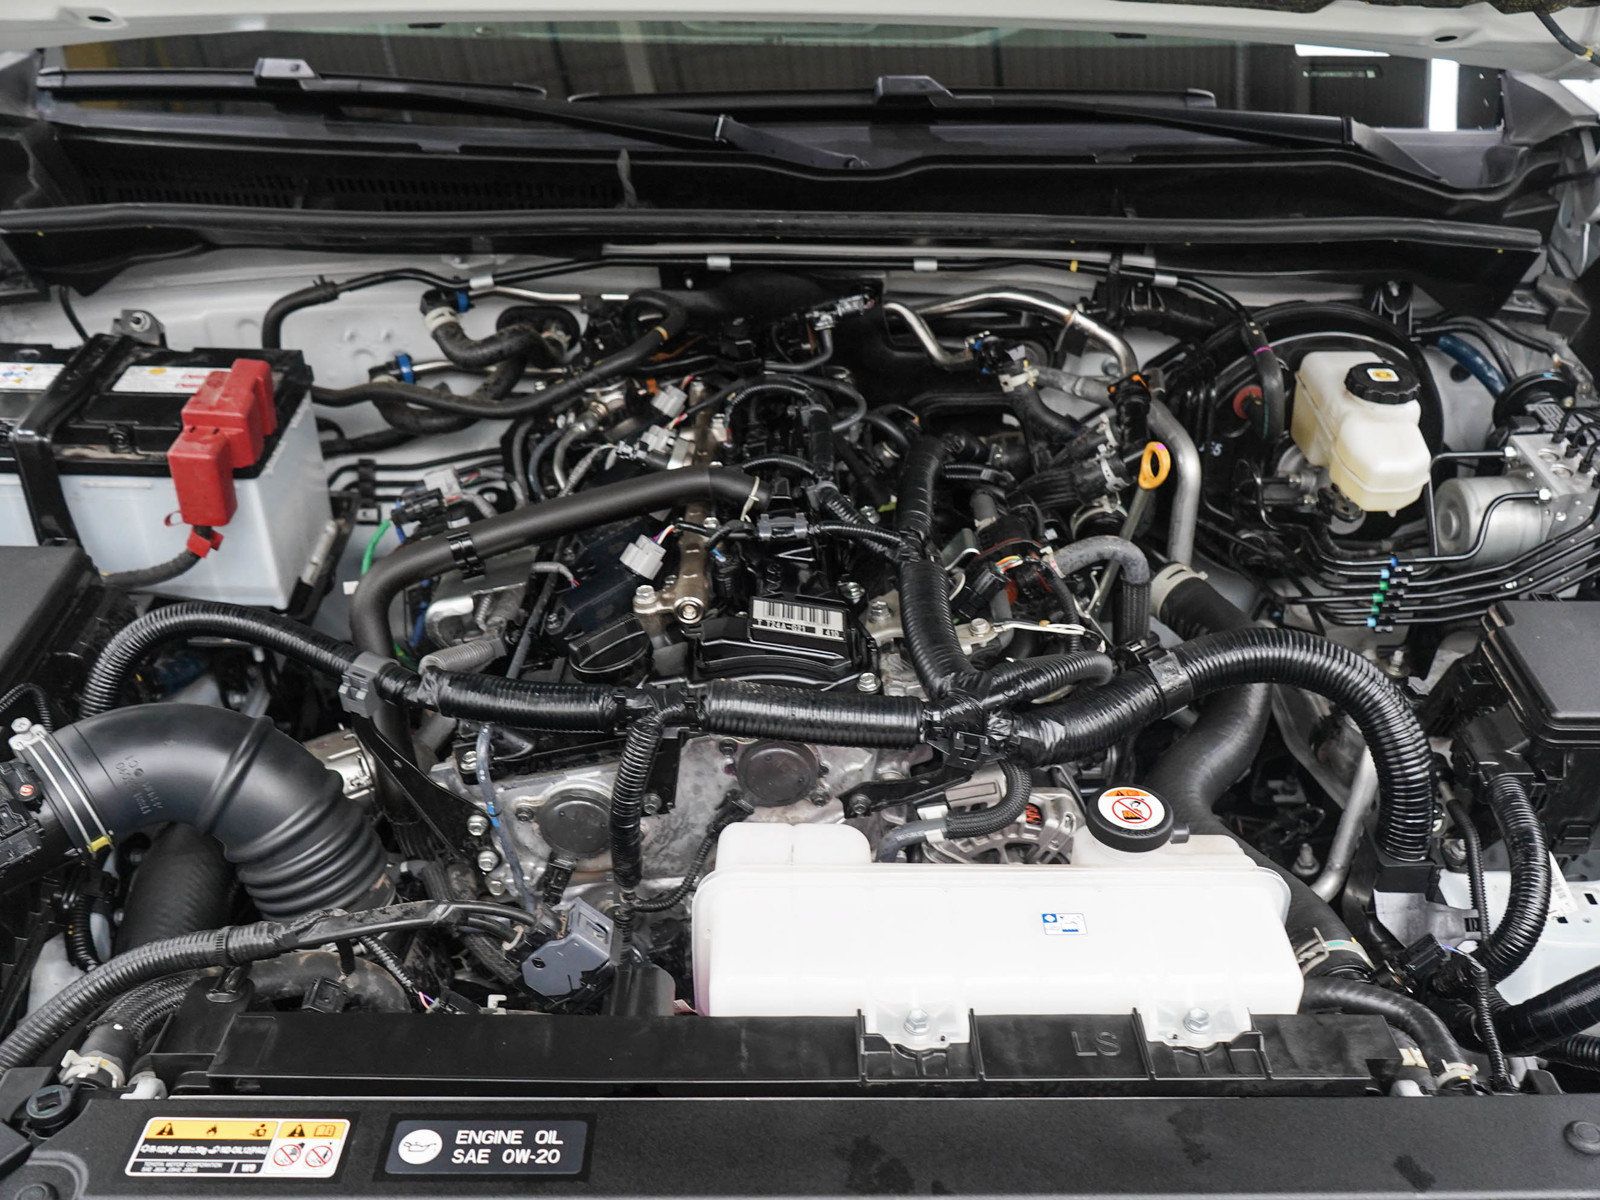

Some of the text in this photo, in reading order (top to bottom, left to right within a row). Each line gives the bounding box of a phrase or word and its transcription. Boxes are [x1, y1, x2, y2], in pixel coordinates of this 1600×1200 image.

[1071, 1031, 1120, 1056] LS
[455, 1130, 564, 1144] ENGINE OIL
[451, 1148, 561, 1164] SAE 0W-20
